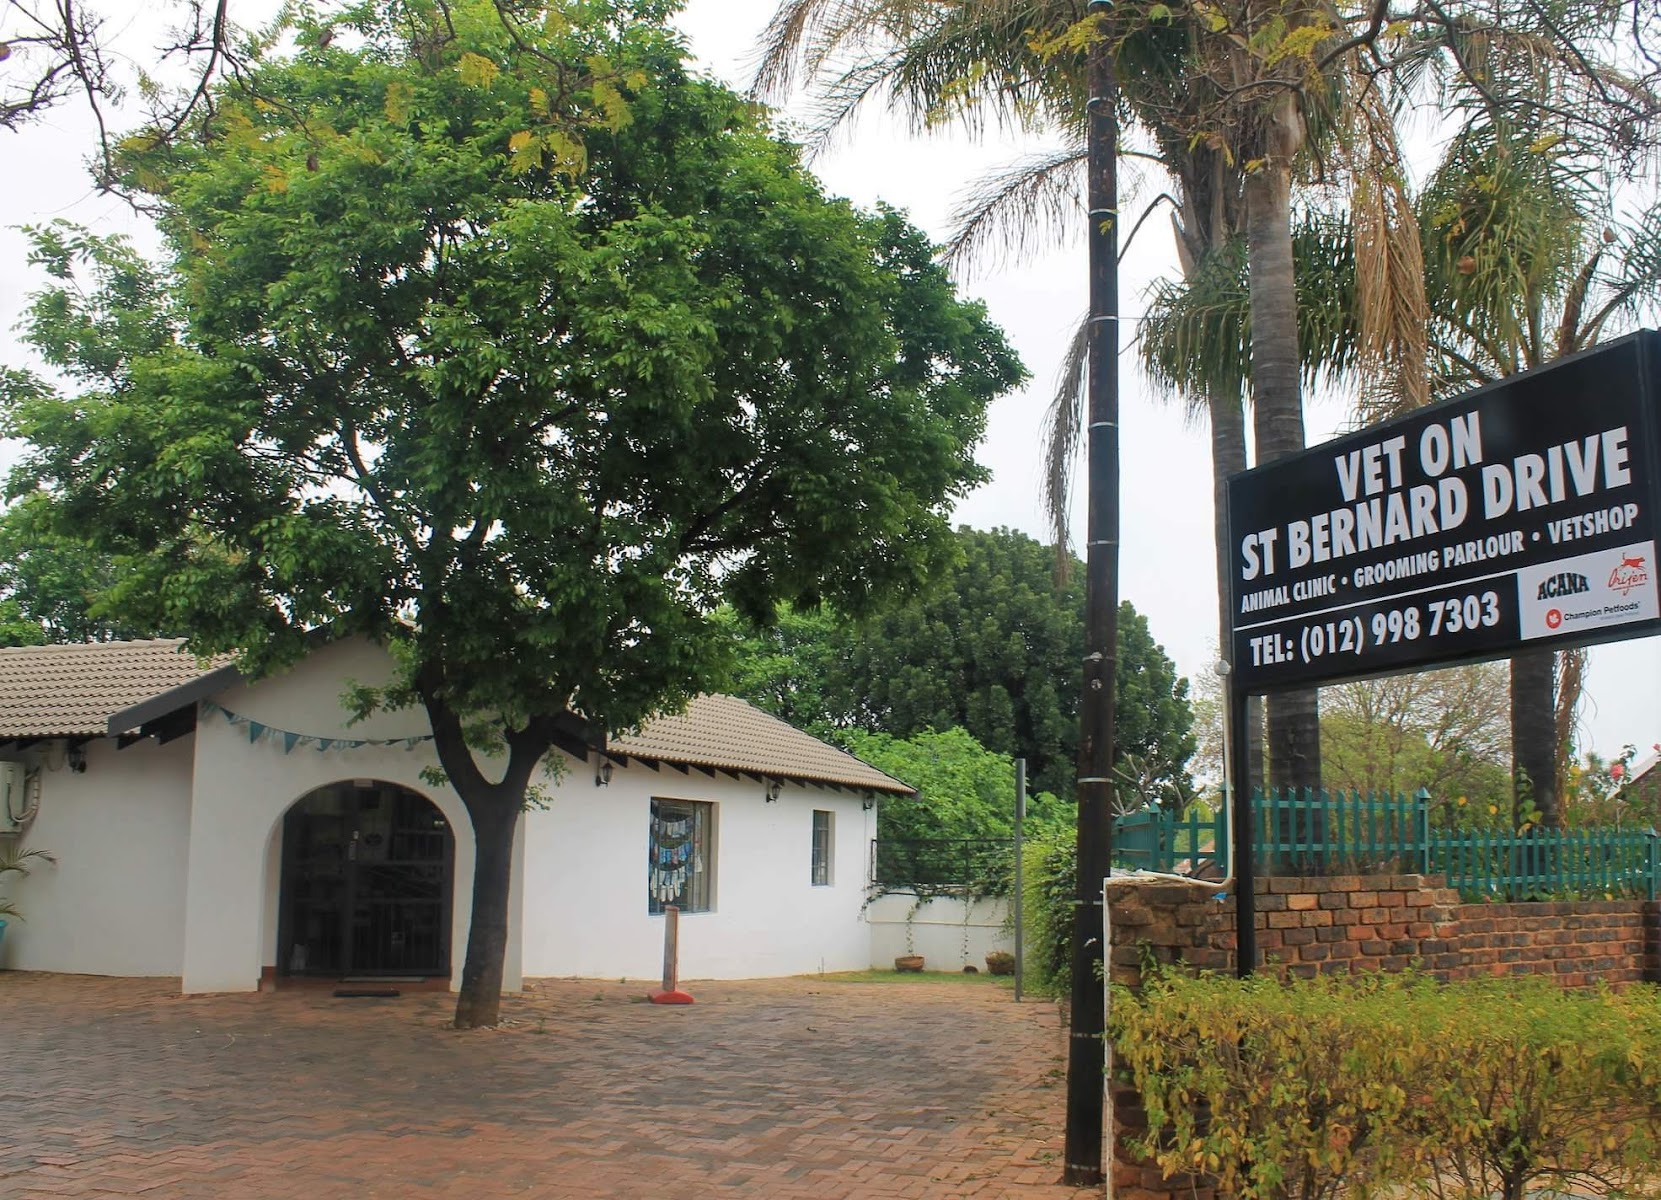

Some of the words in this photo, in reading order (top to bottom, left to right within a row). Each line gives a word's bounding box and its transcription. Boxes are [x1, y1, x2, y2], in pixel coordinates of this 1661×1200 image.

[1335, 435, 1406, 501] VET
[1419, 410, 1483, 477] ON
[1241, 528, 1278, 581] ST
[1287, 476, 1468, 569] BERNARD
[1482, 426, 1632, 520] DRIVE
[1241, 588, 1290, 614] ANIMAL
[1292, 574, 1336, 601] CLINIC
[1353, 550, 1440, 589] GROOMING
[1443, 530, 1525, 569] PARLOUR
[1547, 503, 1639, 544] VETSHOP
[1537, 572, 1590, 600] ACANA
[1250, 635, 1294, 667] TEL:
[1301, 619, 1363, 664] (012)
[1371, 606, 1421, 646] 998
[1429, 591, 1500, 637] 7303
[1563, 609, 1602, 621] Champion
